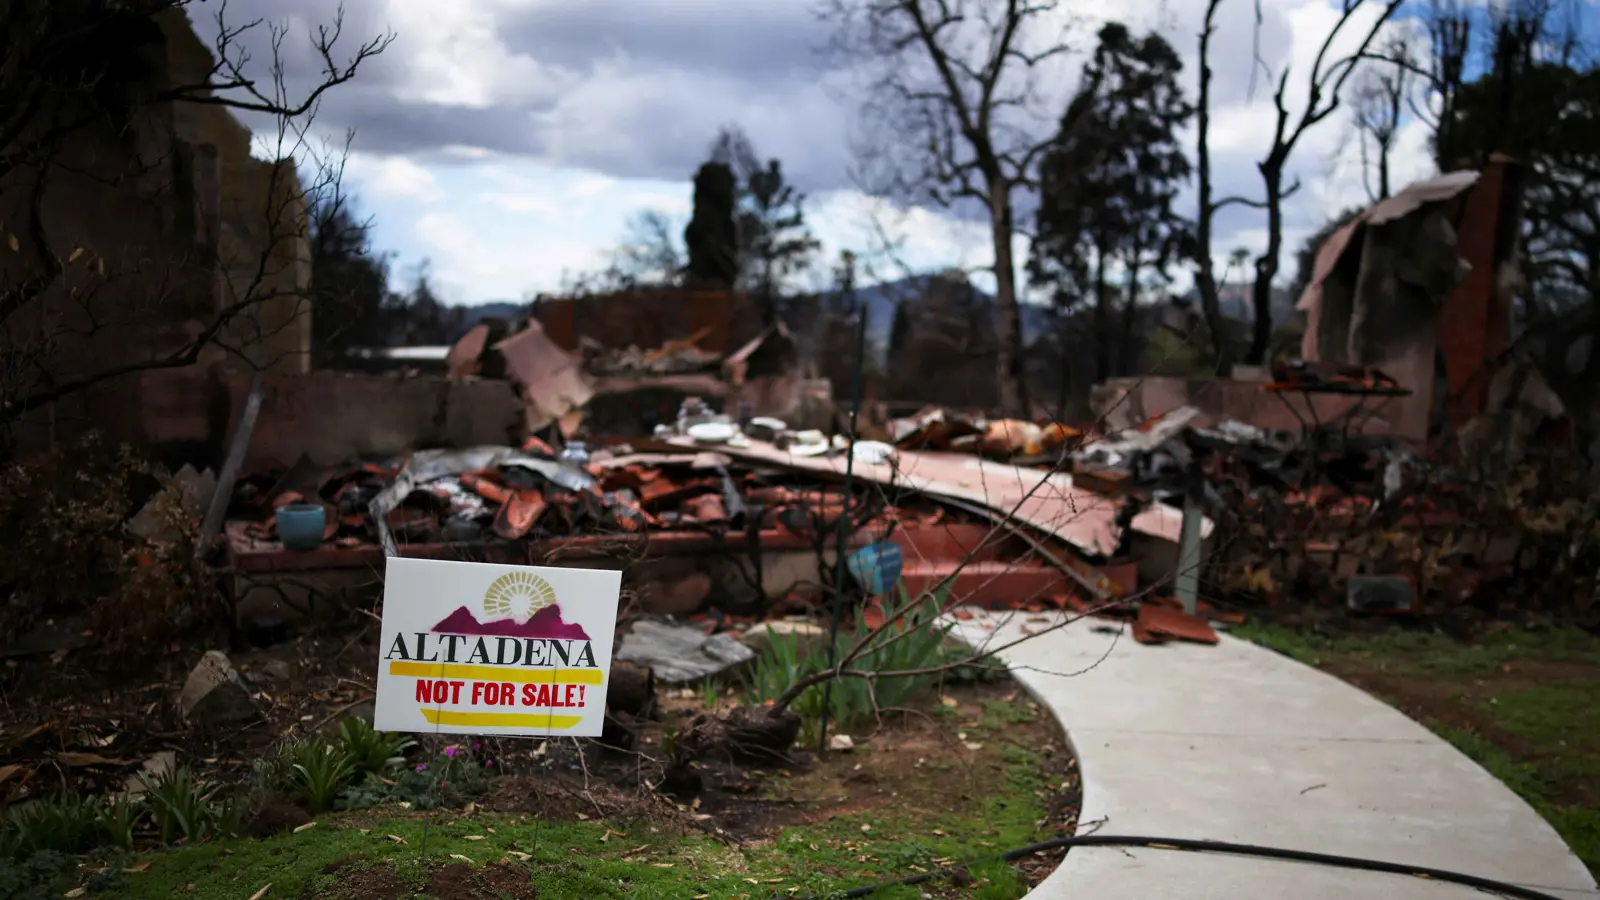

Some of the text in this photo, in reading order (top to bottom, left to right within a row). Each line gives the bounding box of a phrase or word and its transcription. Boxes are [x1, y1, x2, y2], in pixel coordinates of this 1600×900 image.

[383, 631, 599, 668] ALTADENA
[415, 679, 586, 708] NOT FOR SALE!
